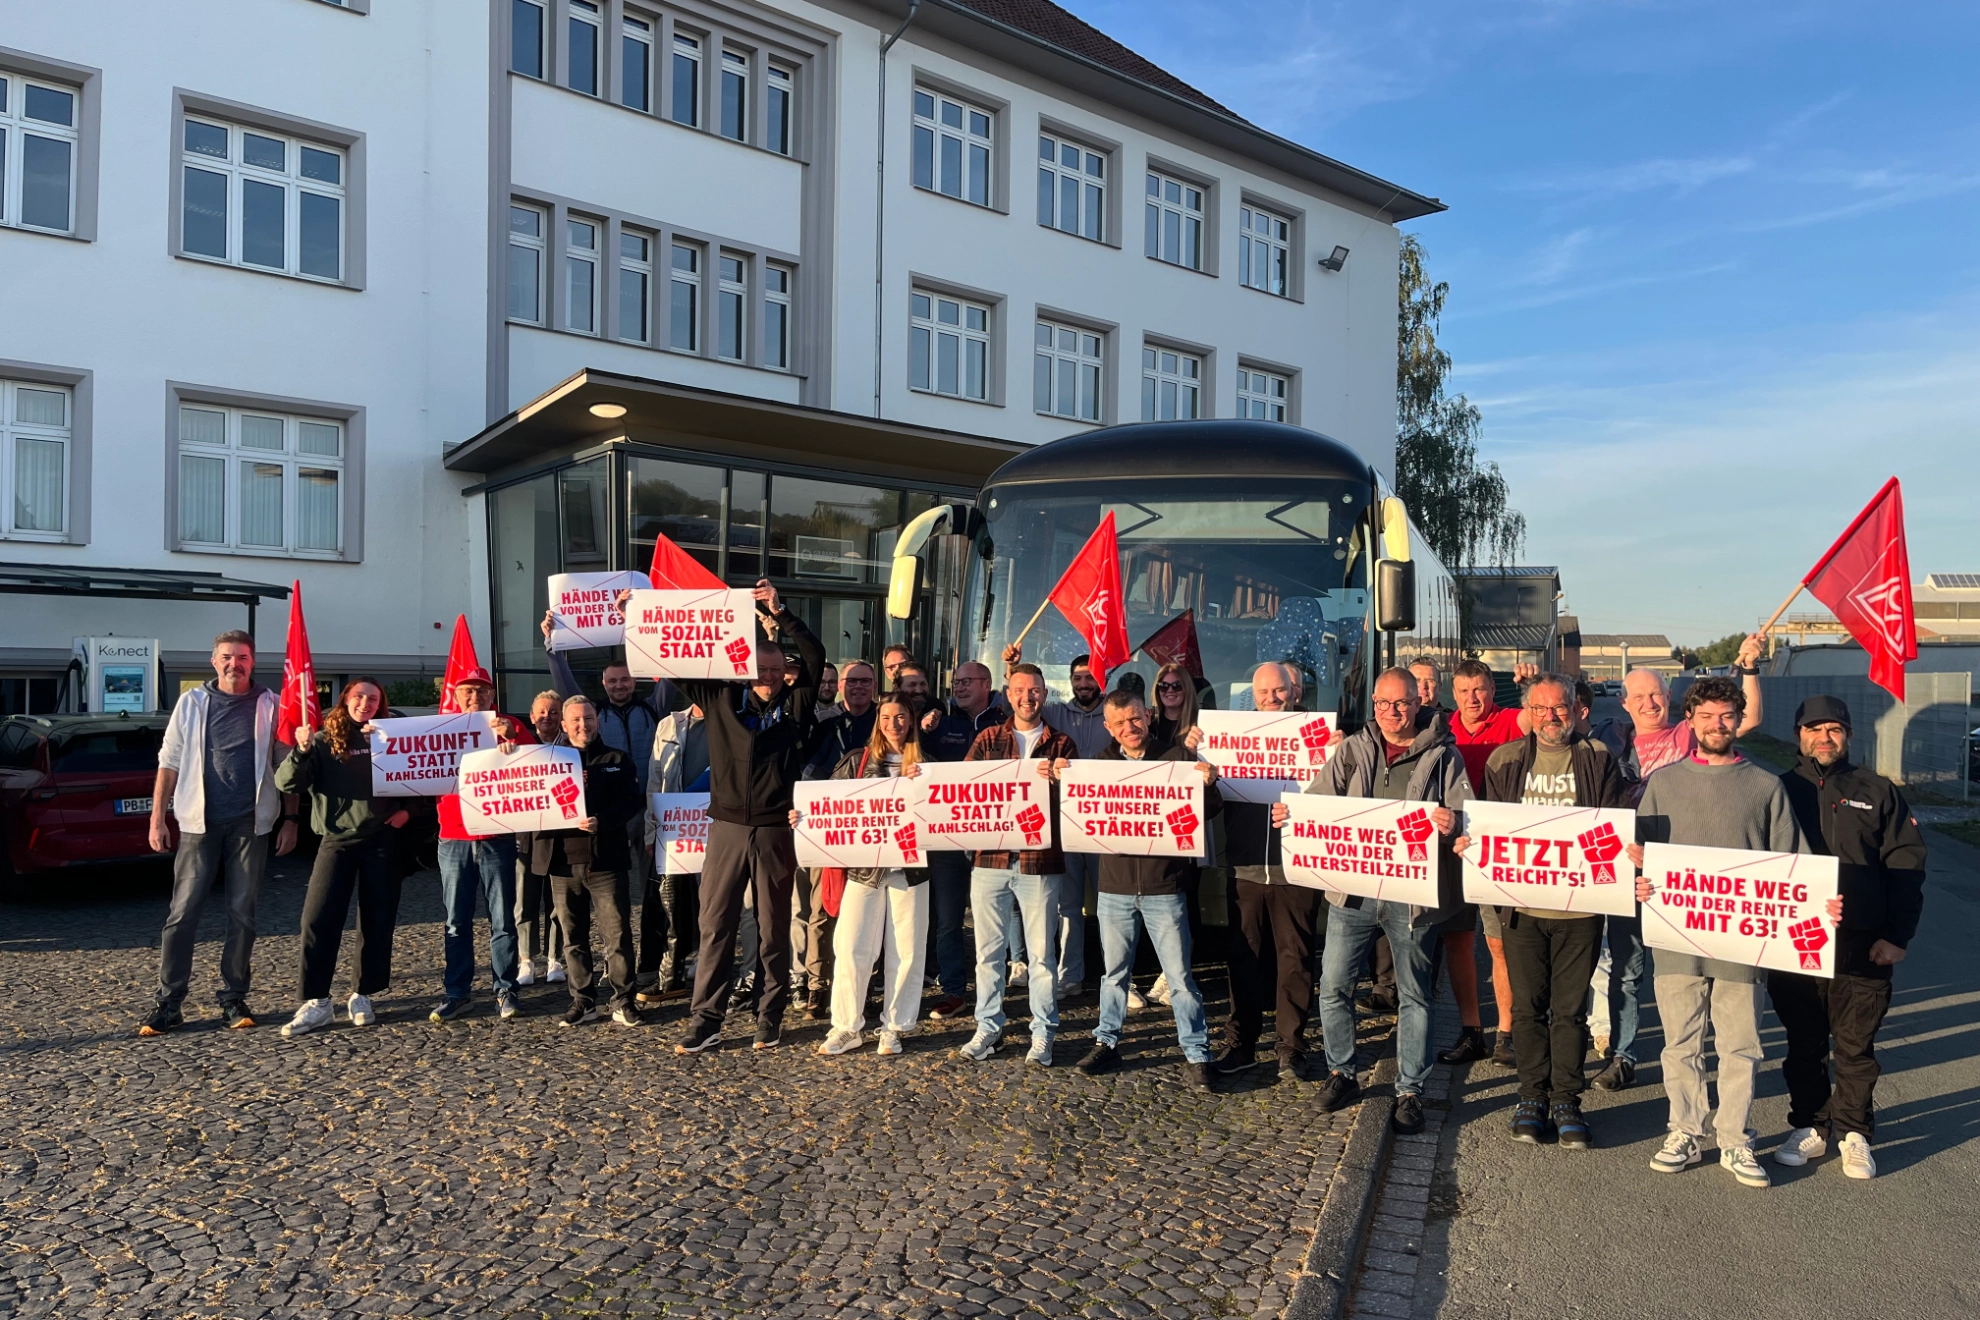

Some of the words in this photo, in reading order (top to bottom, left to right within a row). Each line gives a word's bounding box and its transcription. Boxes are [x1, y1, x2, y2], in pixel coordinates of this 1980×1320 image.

[561, 588, 609, 605] HÄNDE
[560, 605, 582, 616] VON
[584, 603, 605, 614] DER
[643, 606, 696, 624] HÄNDE
[700, 609, 735, 624] WEG
[576, 613, 604, 628] MIT
[607, 613, 625, 626] 63
[638, 626, 659, 635] VOM
[661, 625, 730, 641] SOZIAL-
[660, 643, 715, 659] STAAT
[386, 731, 482, 755] ZUKUNFT
[1209, 733, 1260, 750] HÄNDE
[1265, 737, 1299, 751] WEG
[408, 751, 457, 769] STATT
[1236, 752, 1264, 764] VON
[1269, 753, 1296, 765] DER
[386, 766, 460, 782] KAHLSCHLA
[464, 762, 573, 785] ZUSAMMENHALT
[1216, 765, 1320, 782] LTERSTEILZEIT
[474, 785, 493, 798] IST
[496, 779, 545, 795] UNSERE
[1525, 772, 1576, 793] MUST
[929, 782, 1031, 804] ZUKUNFT
[1068, 784, 1193, 799] ZUSAMMENHALT
[124, 801, 138, 811] PB
[482, 795, 551, 817] STÄRKE!
[663, 806, 709, 822] HÄNDE
[810, 797, 864, 815] HÄNDE
[870, 798, 905, 813] WEG
[951, 805, 1003, 820] STATT
[1078, 801, 1100, 813] IST
[1105, 802, 1160, 815] UNSERE
[661, 824, 676, 832] VOM
[678, 822, 712, 838] SOZI
[808, 818, 831, 829] VON
[836, 817, 858, 828] DER
[862, 816, 900, 827] RENTE
[929, 821, 1013, 833] KAHLSCHLAG!
[1086, 817, 1163, 837] STÄRKE!
[826, 830, 856, 845] MIT
[862, 829, 887, 844] 63!
[1293, 819, 1353, 842] HÄNDE
[1357, 827, 1397, 846] WEG
[675, 838, 705, 853] STA
[1325, 841, 1358, 858] VON
[1362, 846, 1394, 861] DER
[1477, 834, 1574, 869] JETZT
[1292, 853, 1428, 881] ALTERSTEILZEIT!
[1665, 867, 1747, 897] HÄNDE
[1754, 879, 1808, 903] WEG
[1661, 892, 1697, 909] VON
[1701, 896, 1736, 913] DER
[1741, 901, 1798, 919] RENTE
[1685, 911, 1732, 933] MIT
[1739, 917, 1778, 939] 63!
